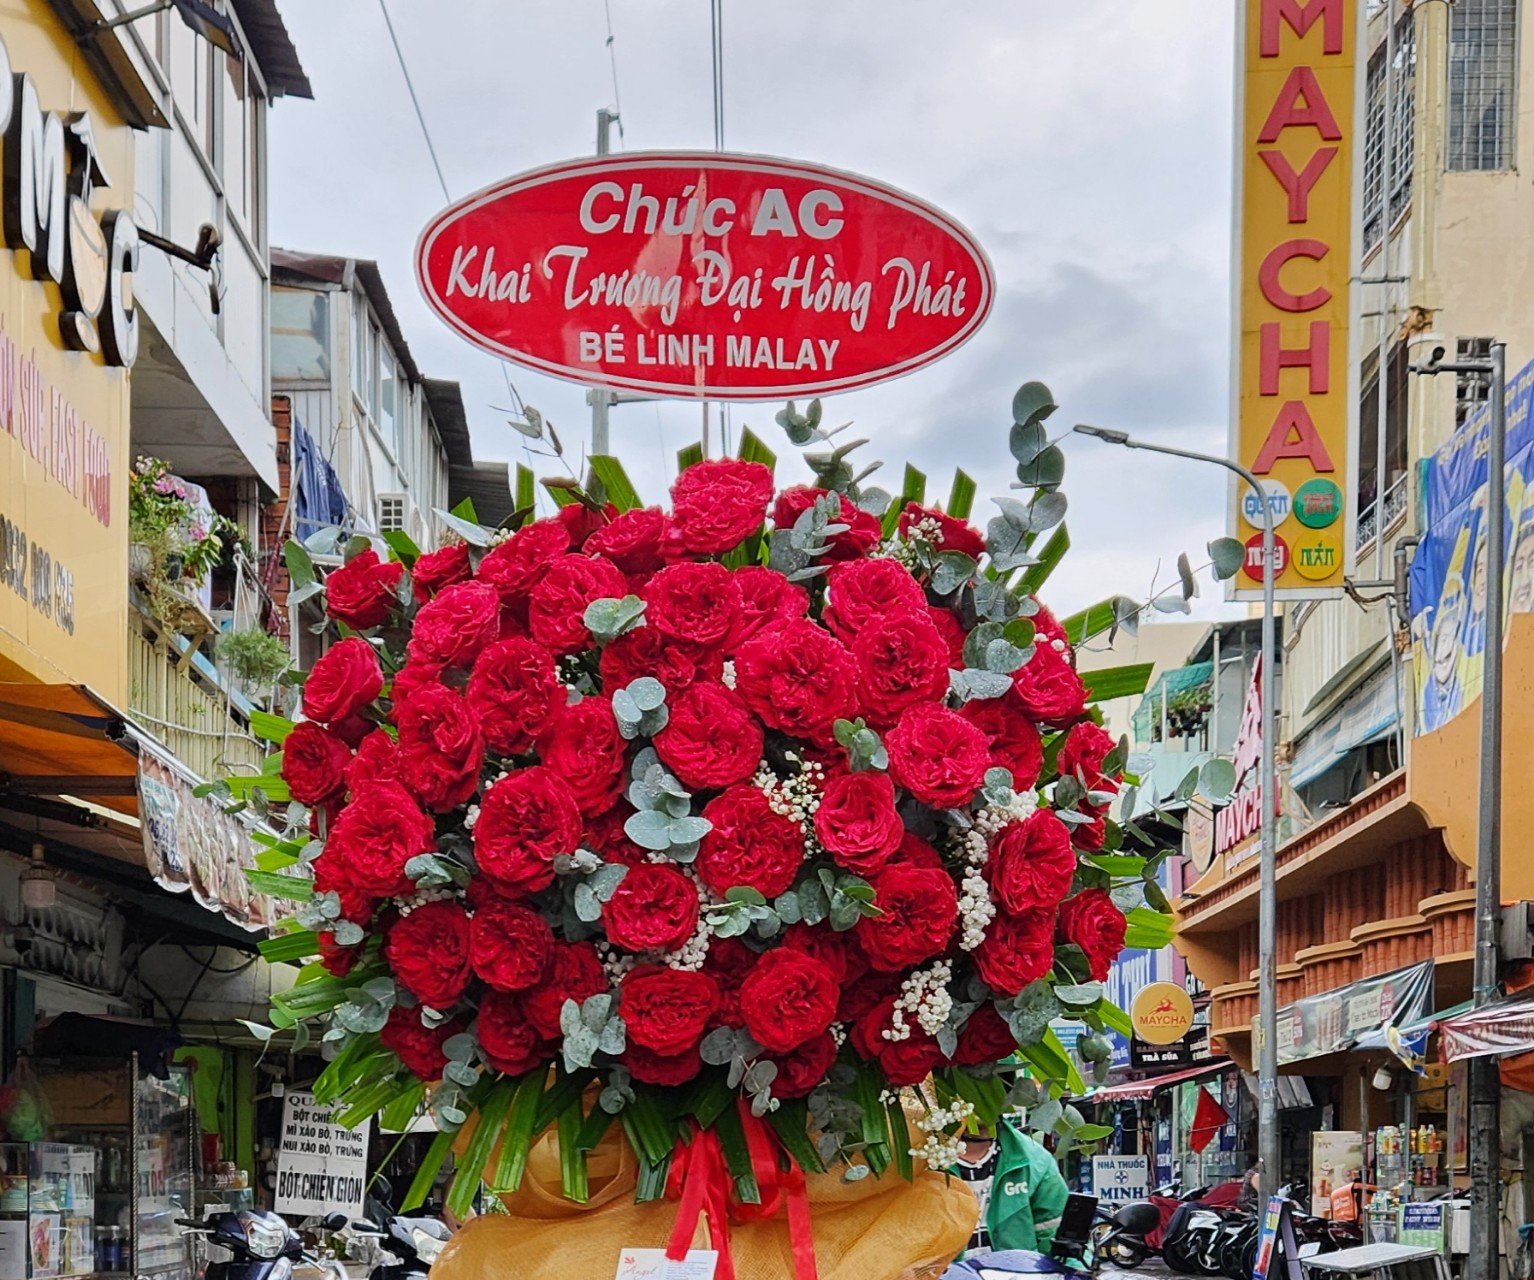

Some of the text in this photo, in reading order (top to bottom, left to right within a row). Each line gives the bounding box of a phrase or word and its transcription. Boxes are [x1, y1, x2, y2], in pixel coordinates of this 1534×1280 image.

[579, 181, 845, 240] Chúc AC
[1250, 0, 1343, 474] MAYCHA
[446, 246, 967, 333] Khai Trương Đại Hồng Phát
[579, 325, 840, 372] BÉ LINH MALAY
[50, 385, 80, 500] FAST
[83, 420, 111, 529] FOOD
[1139, 1015, 1187, 1026] MAYCHA
[293, 1109, 338, 1124] BỘT CHIÊ
[286, 1123, 297, 1136] MÌ
[300, 1125, 317, 1138] XÀO
[282, 1140, 298, 1152] NUI
[300, 1141, 317, 1154] XÀO
[1098, 1159, 1146, 1169] NHÀ THUỐC
[278, 1165, 301, 1205] BỘT
[1100, 1187, 1144, 1200] MINH
